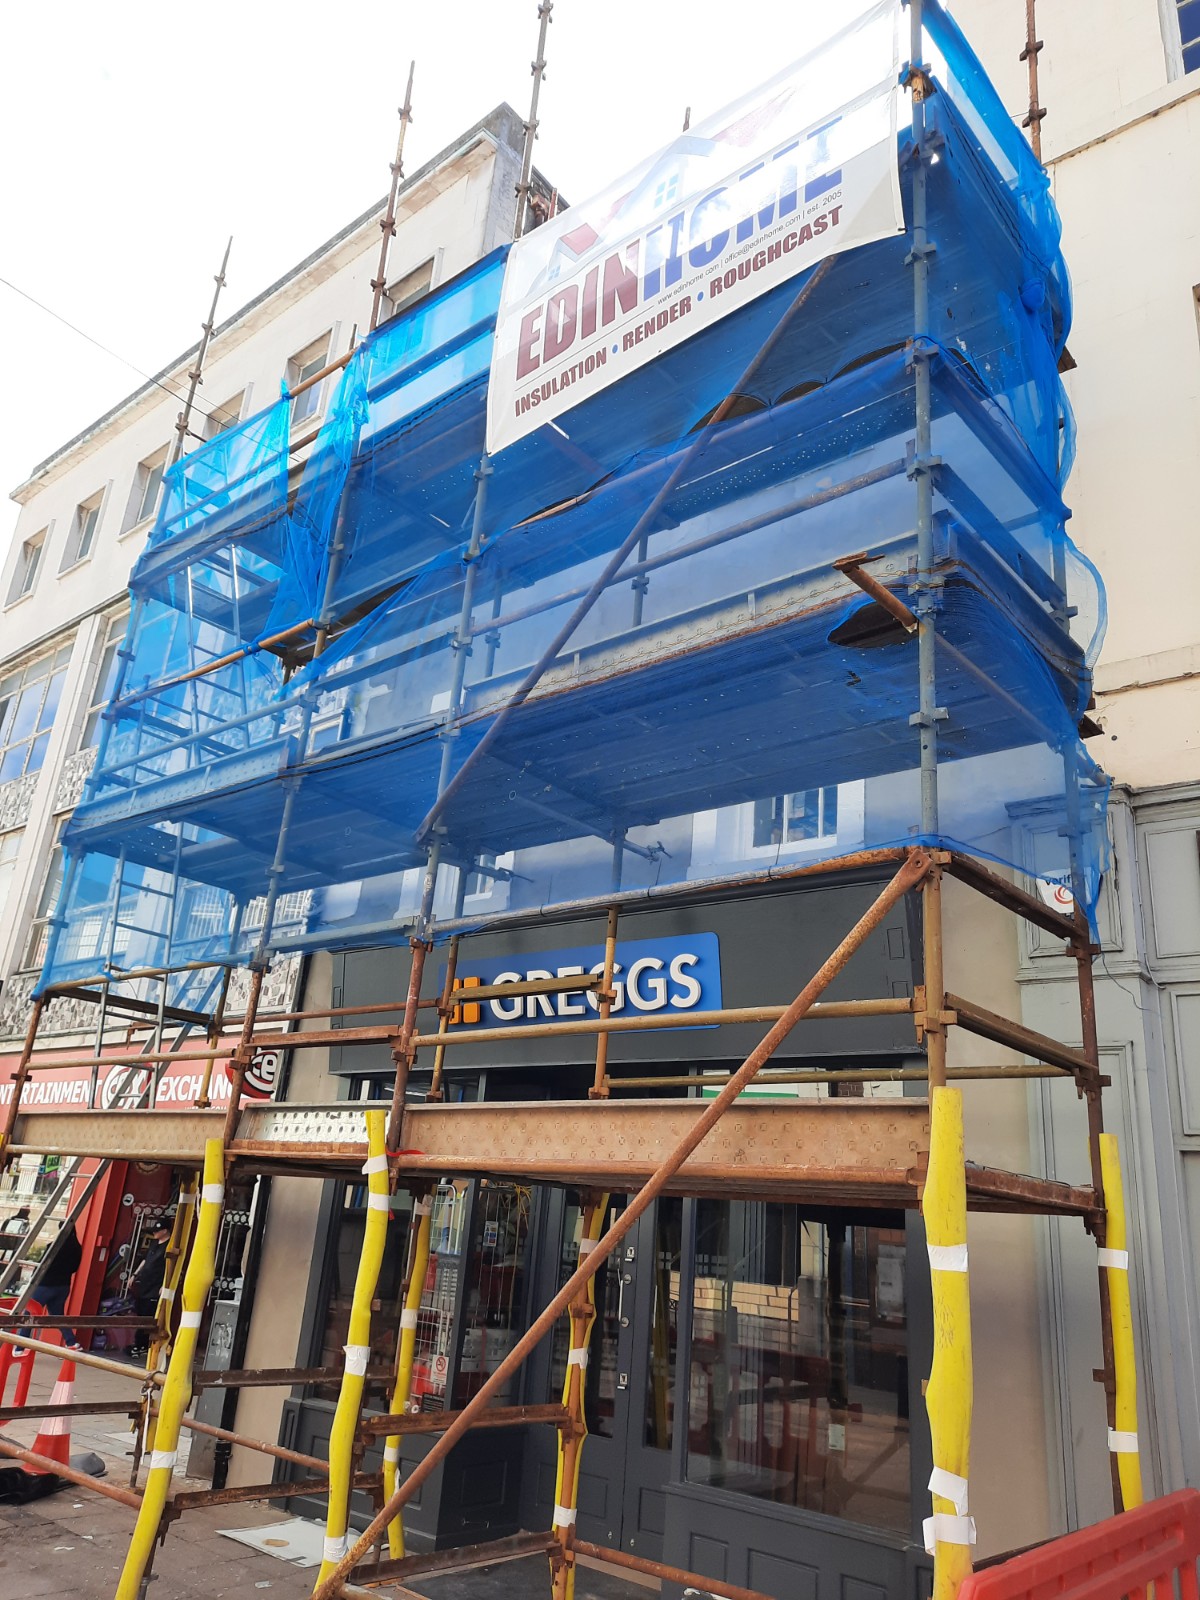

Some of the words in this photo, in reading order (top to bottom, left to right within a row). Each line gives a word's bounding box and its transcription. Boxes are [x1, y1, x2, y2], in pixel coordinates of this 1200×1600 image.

[657, 262, 720, 305] www.edinhome.com
[724, 213, 801, 264] office@edinhome.com
[806, 203, 821, 215] est.
[822, 190, 842, 206] 2005
[515, 347, 607, 417] INSULATION
[622, 295, 692, 352] RENDER
[709, 204, 843, 299] ROUGHCAST
[490, 954, 702, 1020] GREGGS
[0, 1080, 102, 1105] NTRTAINMENT
